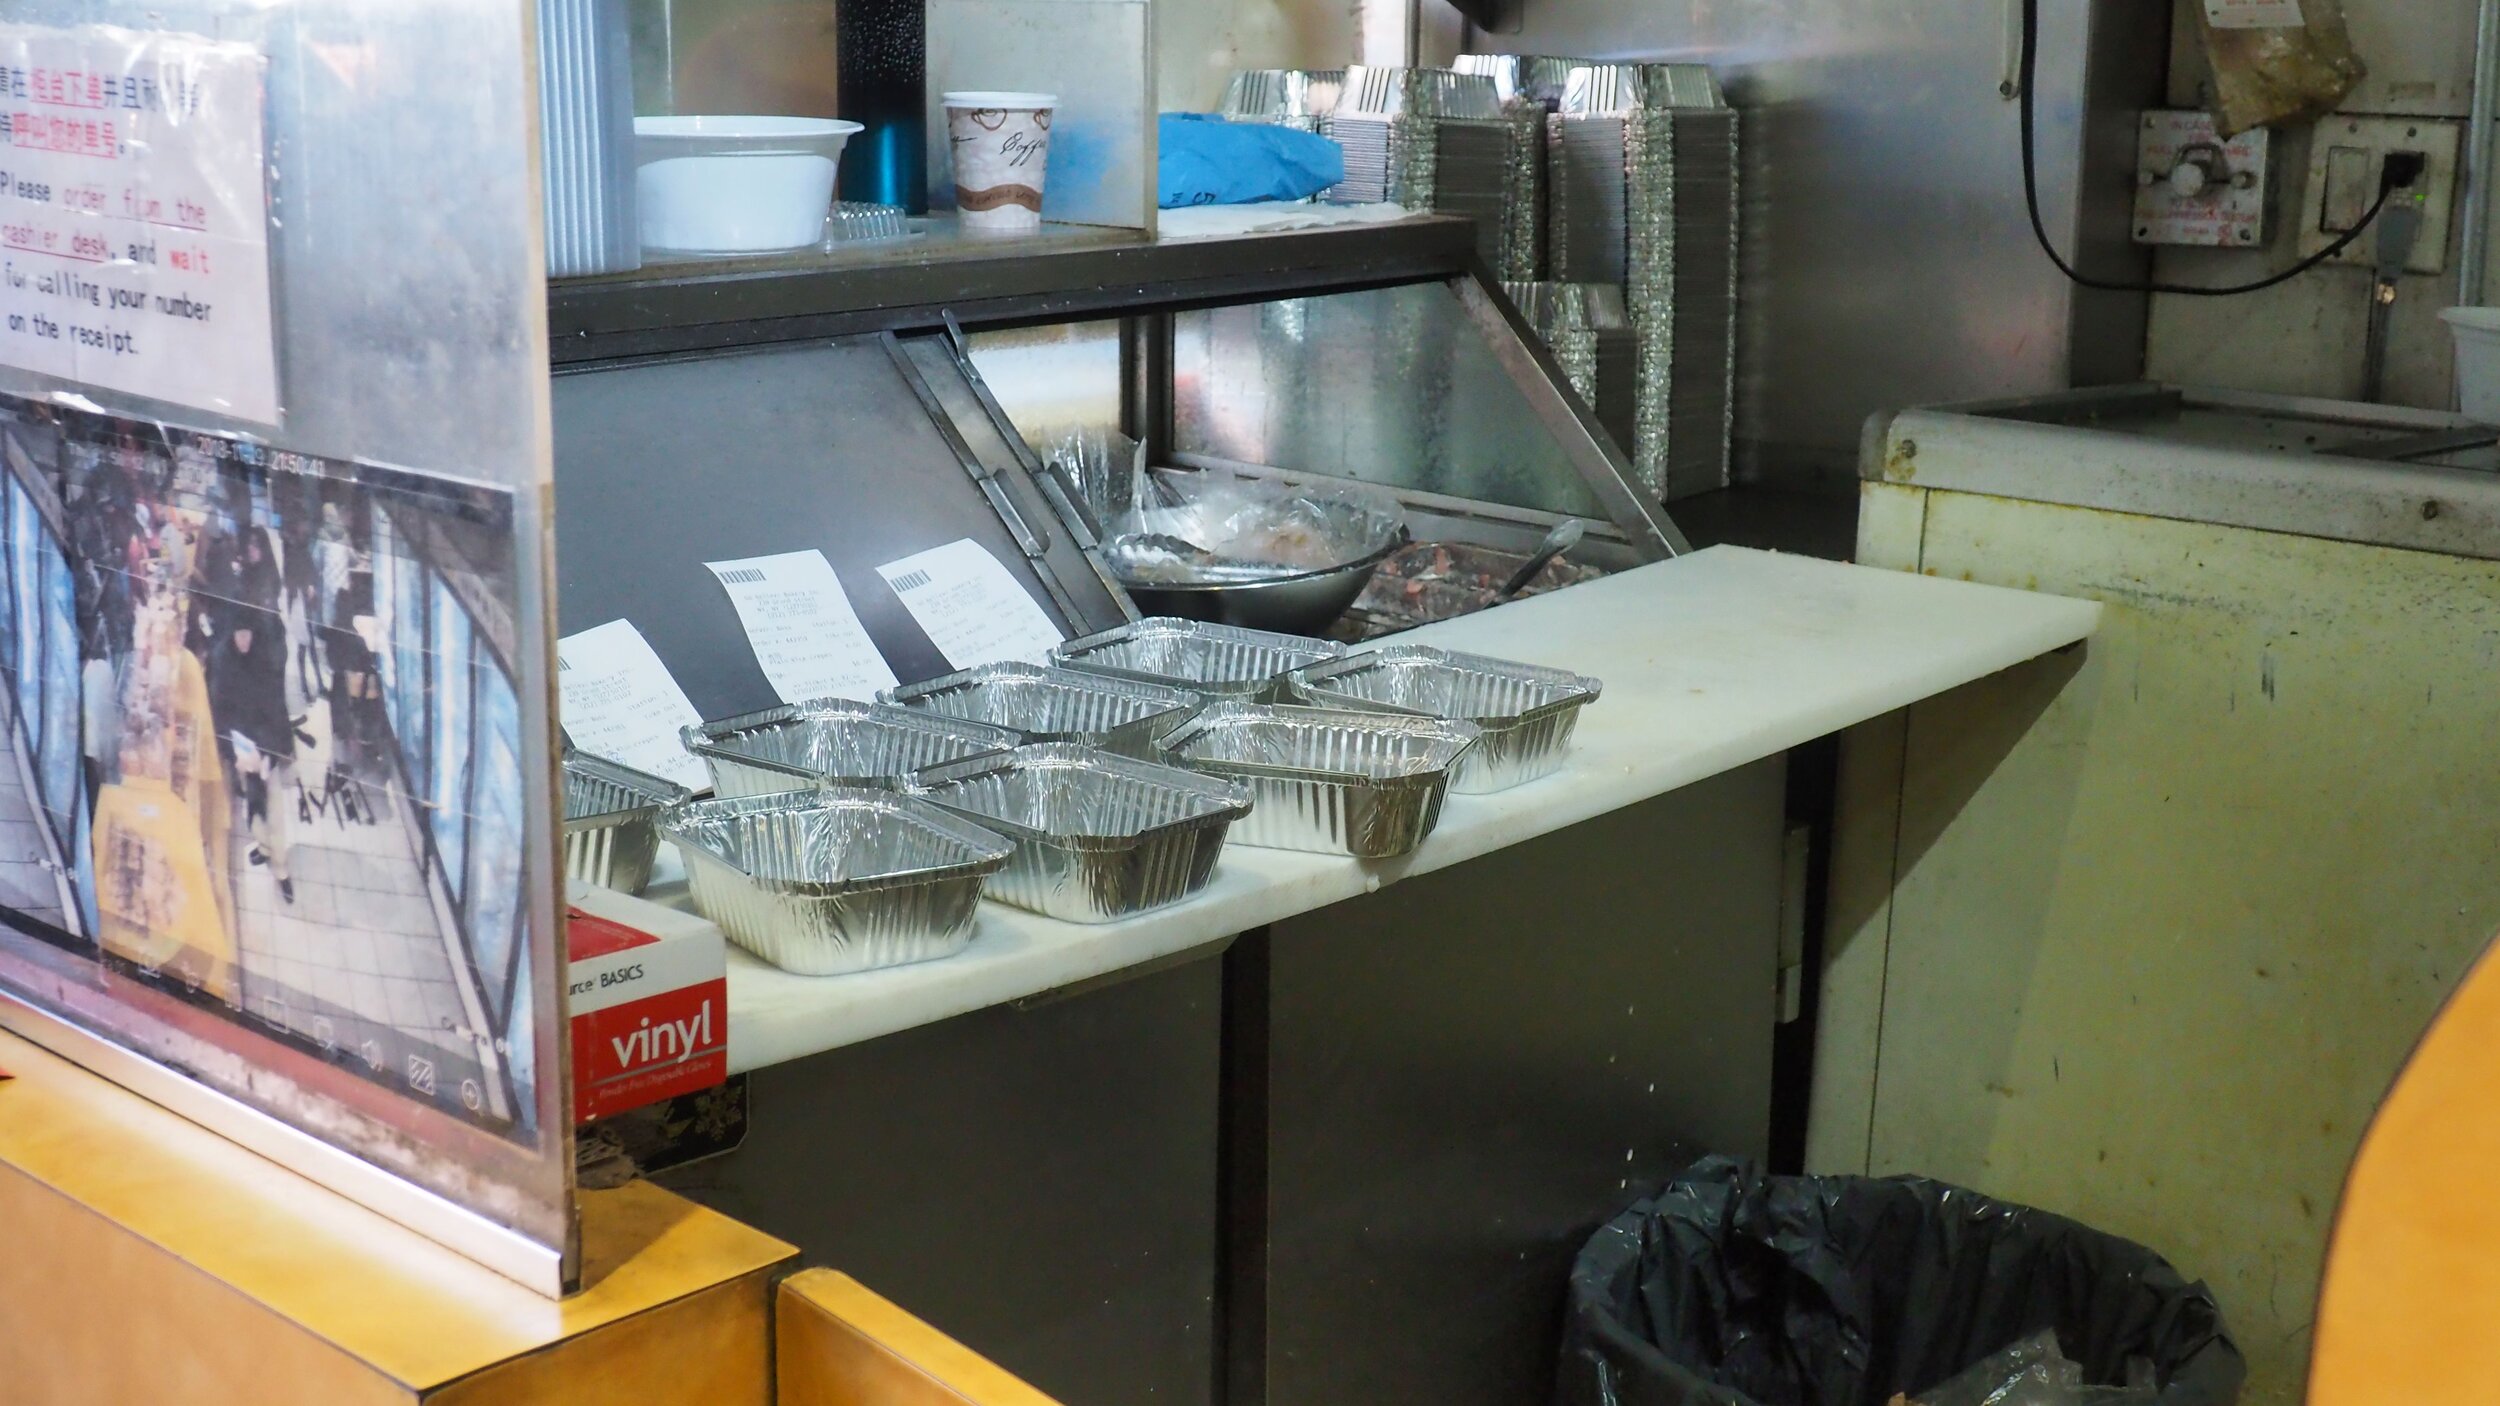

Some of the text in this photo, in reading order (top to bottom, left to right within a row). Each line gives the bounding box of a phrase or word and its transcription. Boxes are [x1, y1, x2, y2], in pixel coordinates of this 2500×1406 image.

[0, 171, 51, 202] Please
[64, 184, 106, 210] order
[177, 196, 207, 224] the
[128, 237, 157, 265] and
[169, 244, 210, 275] wait
[36, 270, 101, 307] calling
[107, 286, 147, 310] your
[155, 291, 212, 322] number
[8, 313, 27, 333] on
[32, 312, 60, 340] the
[600, 964, 644, 988] BASICS
[611, 999, 713, 1068] vinyl
